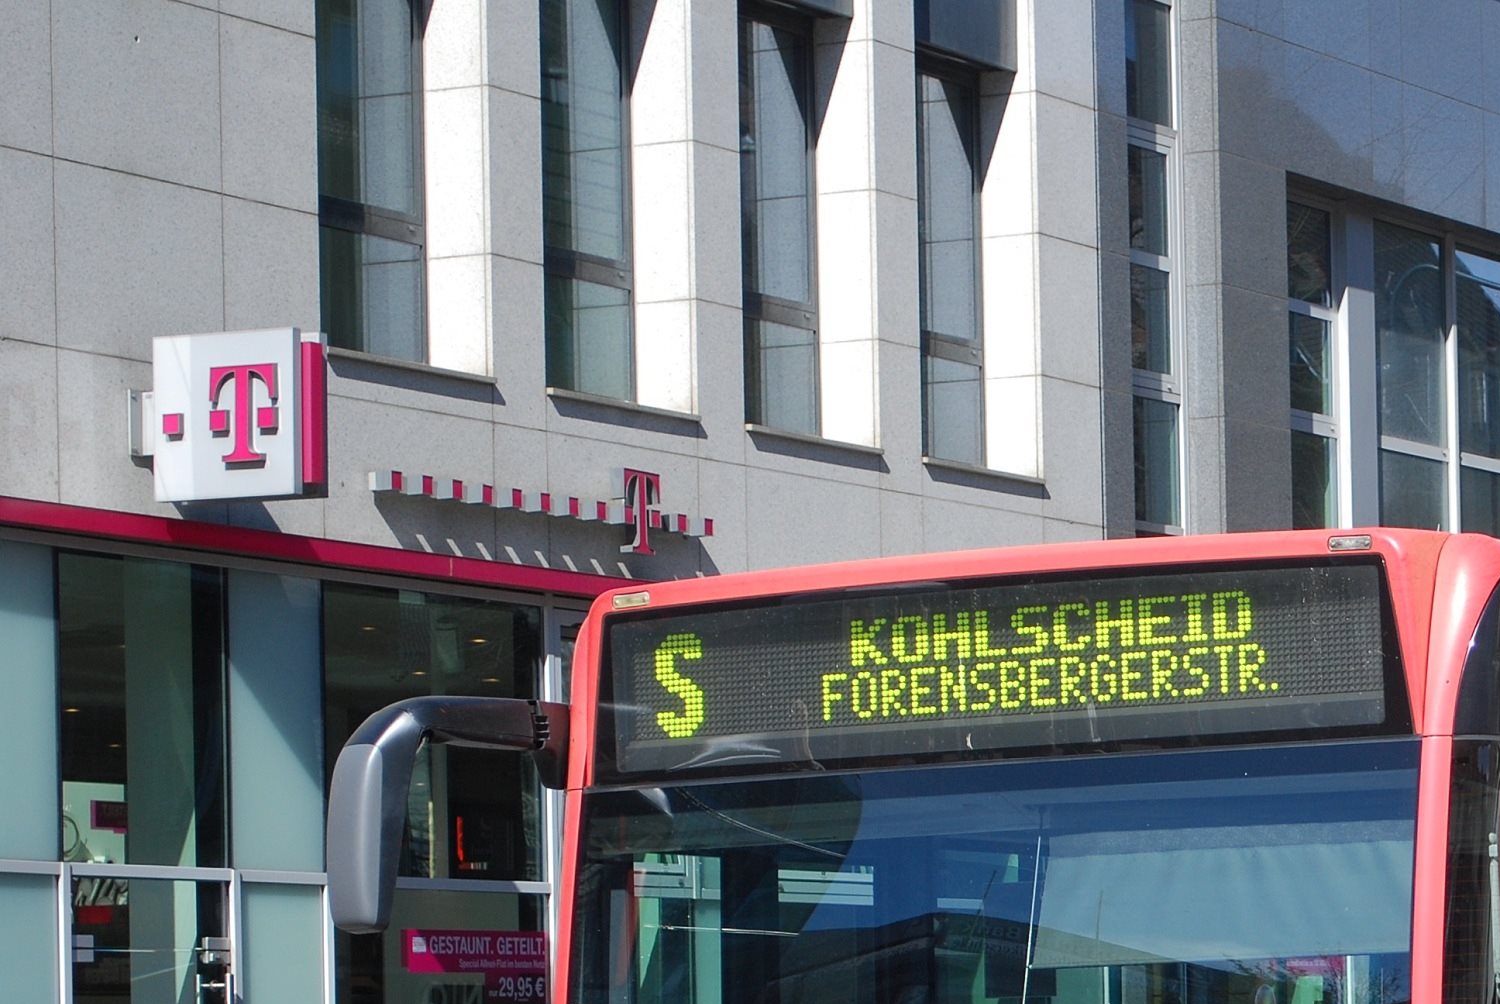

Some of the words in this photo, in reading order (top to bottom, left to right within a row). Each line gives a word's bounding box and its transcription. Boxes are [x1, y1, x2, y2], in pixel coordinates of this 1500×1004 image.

[655, 633, 704, 739] S
[850, 591, 1254, 667] KOHLSCHEID
[821, 642, 1280, 721] FORENSBERGERSTR.
[430, 936, 494, 955] GESTAUNT.
[496, 937, 545, 956] GETEILT.
[498, 977, 532, 999] 29,95
